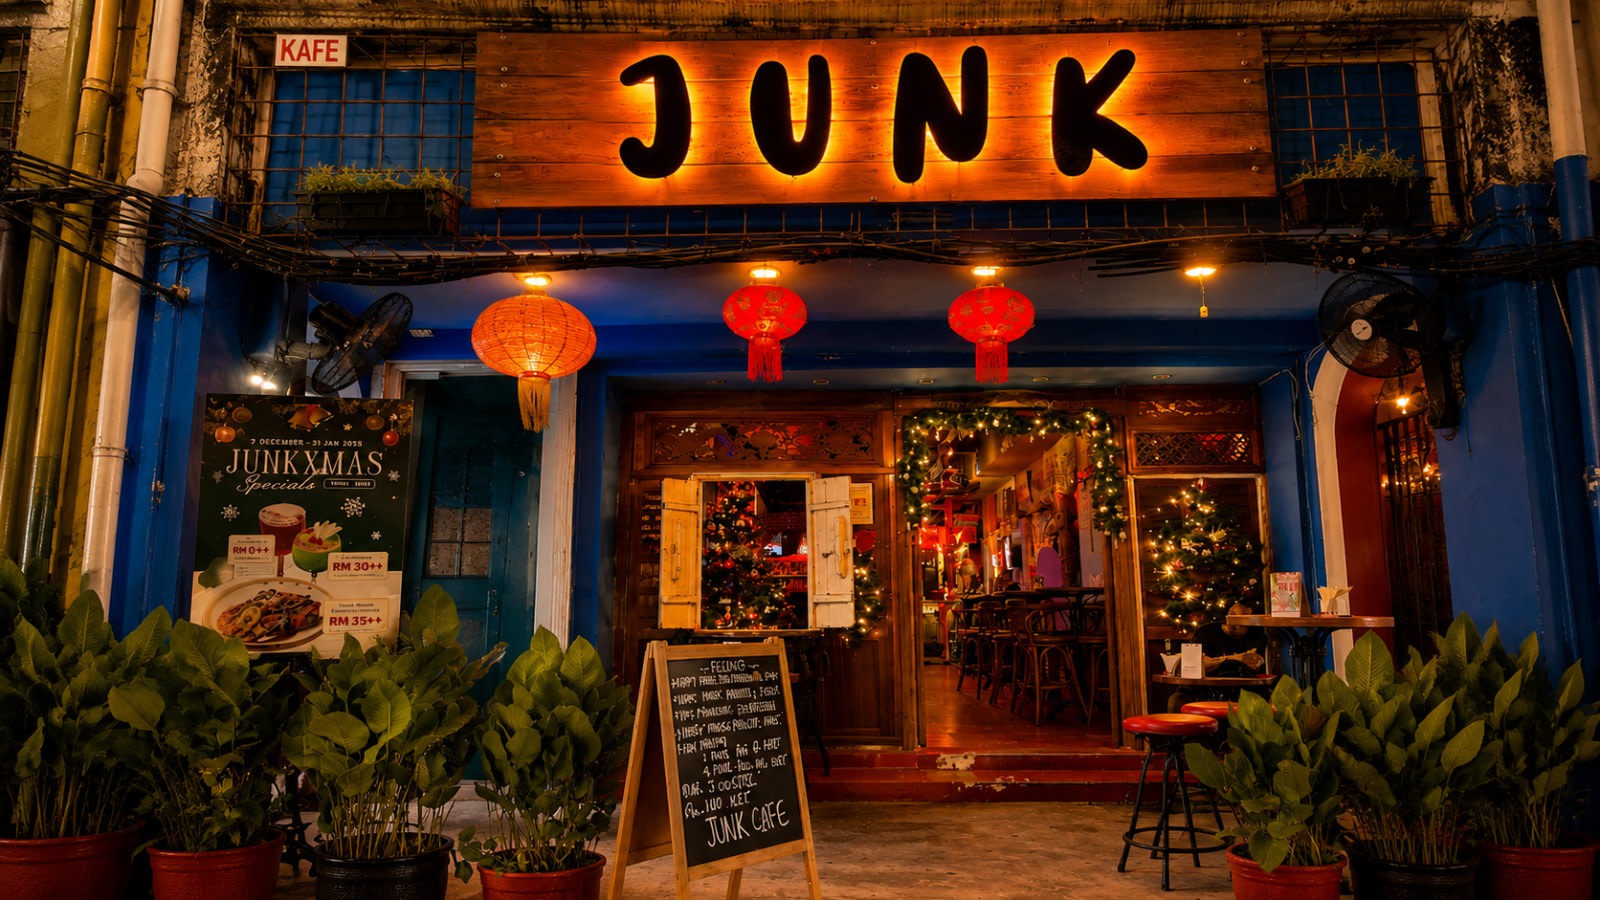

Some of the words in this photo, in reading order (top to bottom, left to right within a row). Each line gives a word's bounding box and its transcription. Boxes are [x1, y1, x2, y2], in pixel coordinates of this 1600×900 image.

[280, 38, 339, 62] KAFE
[619, 45, 1148, 183] JUNK
[259, 438, 304, 446] DECEMBER
[236, 473, 316, 496] Specials
[232, 546, 247, 554] RM
[332, 562, 351, 571] RM
[353, 561, 383, 571] 30++
[329, 616, 349, 626] RM
[351, 616, 382, 626] 35++
[705, 810, 750, 848] JUNK
[751, 799, 790, 833] CAFE
